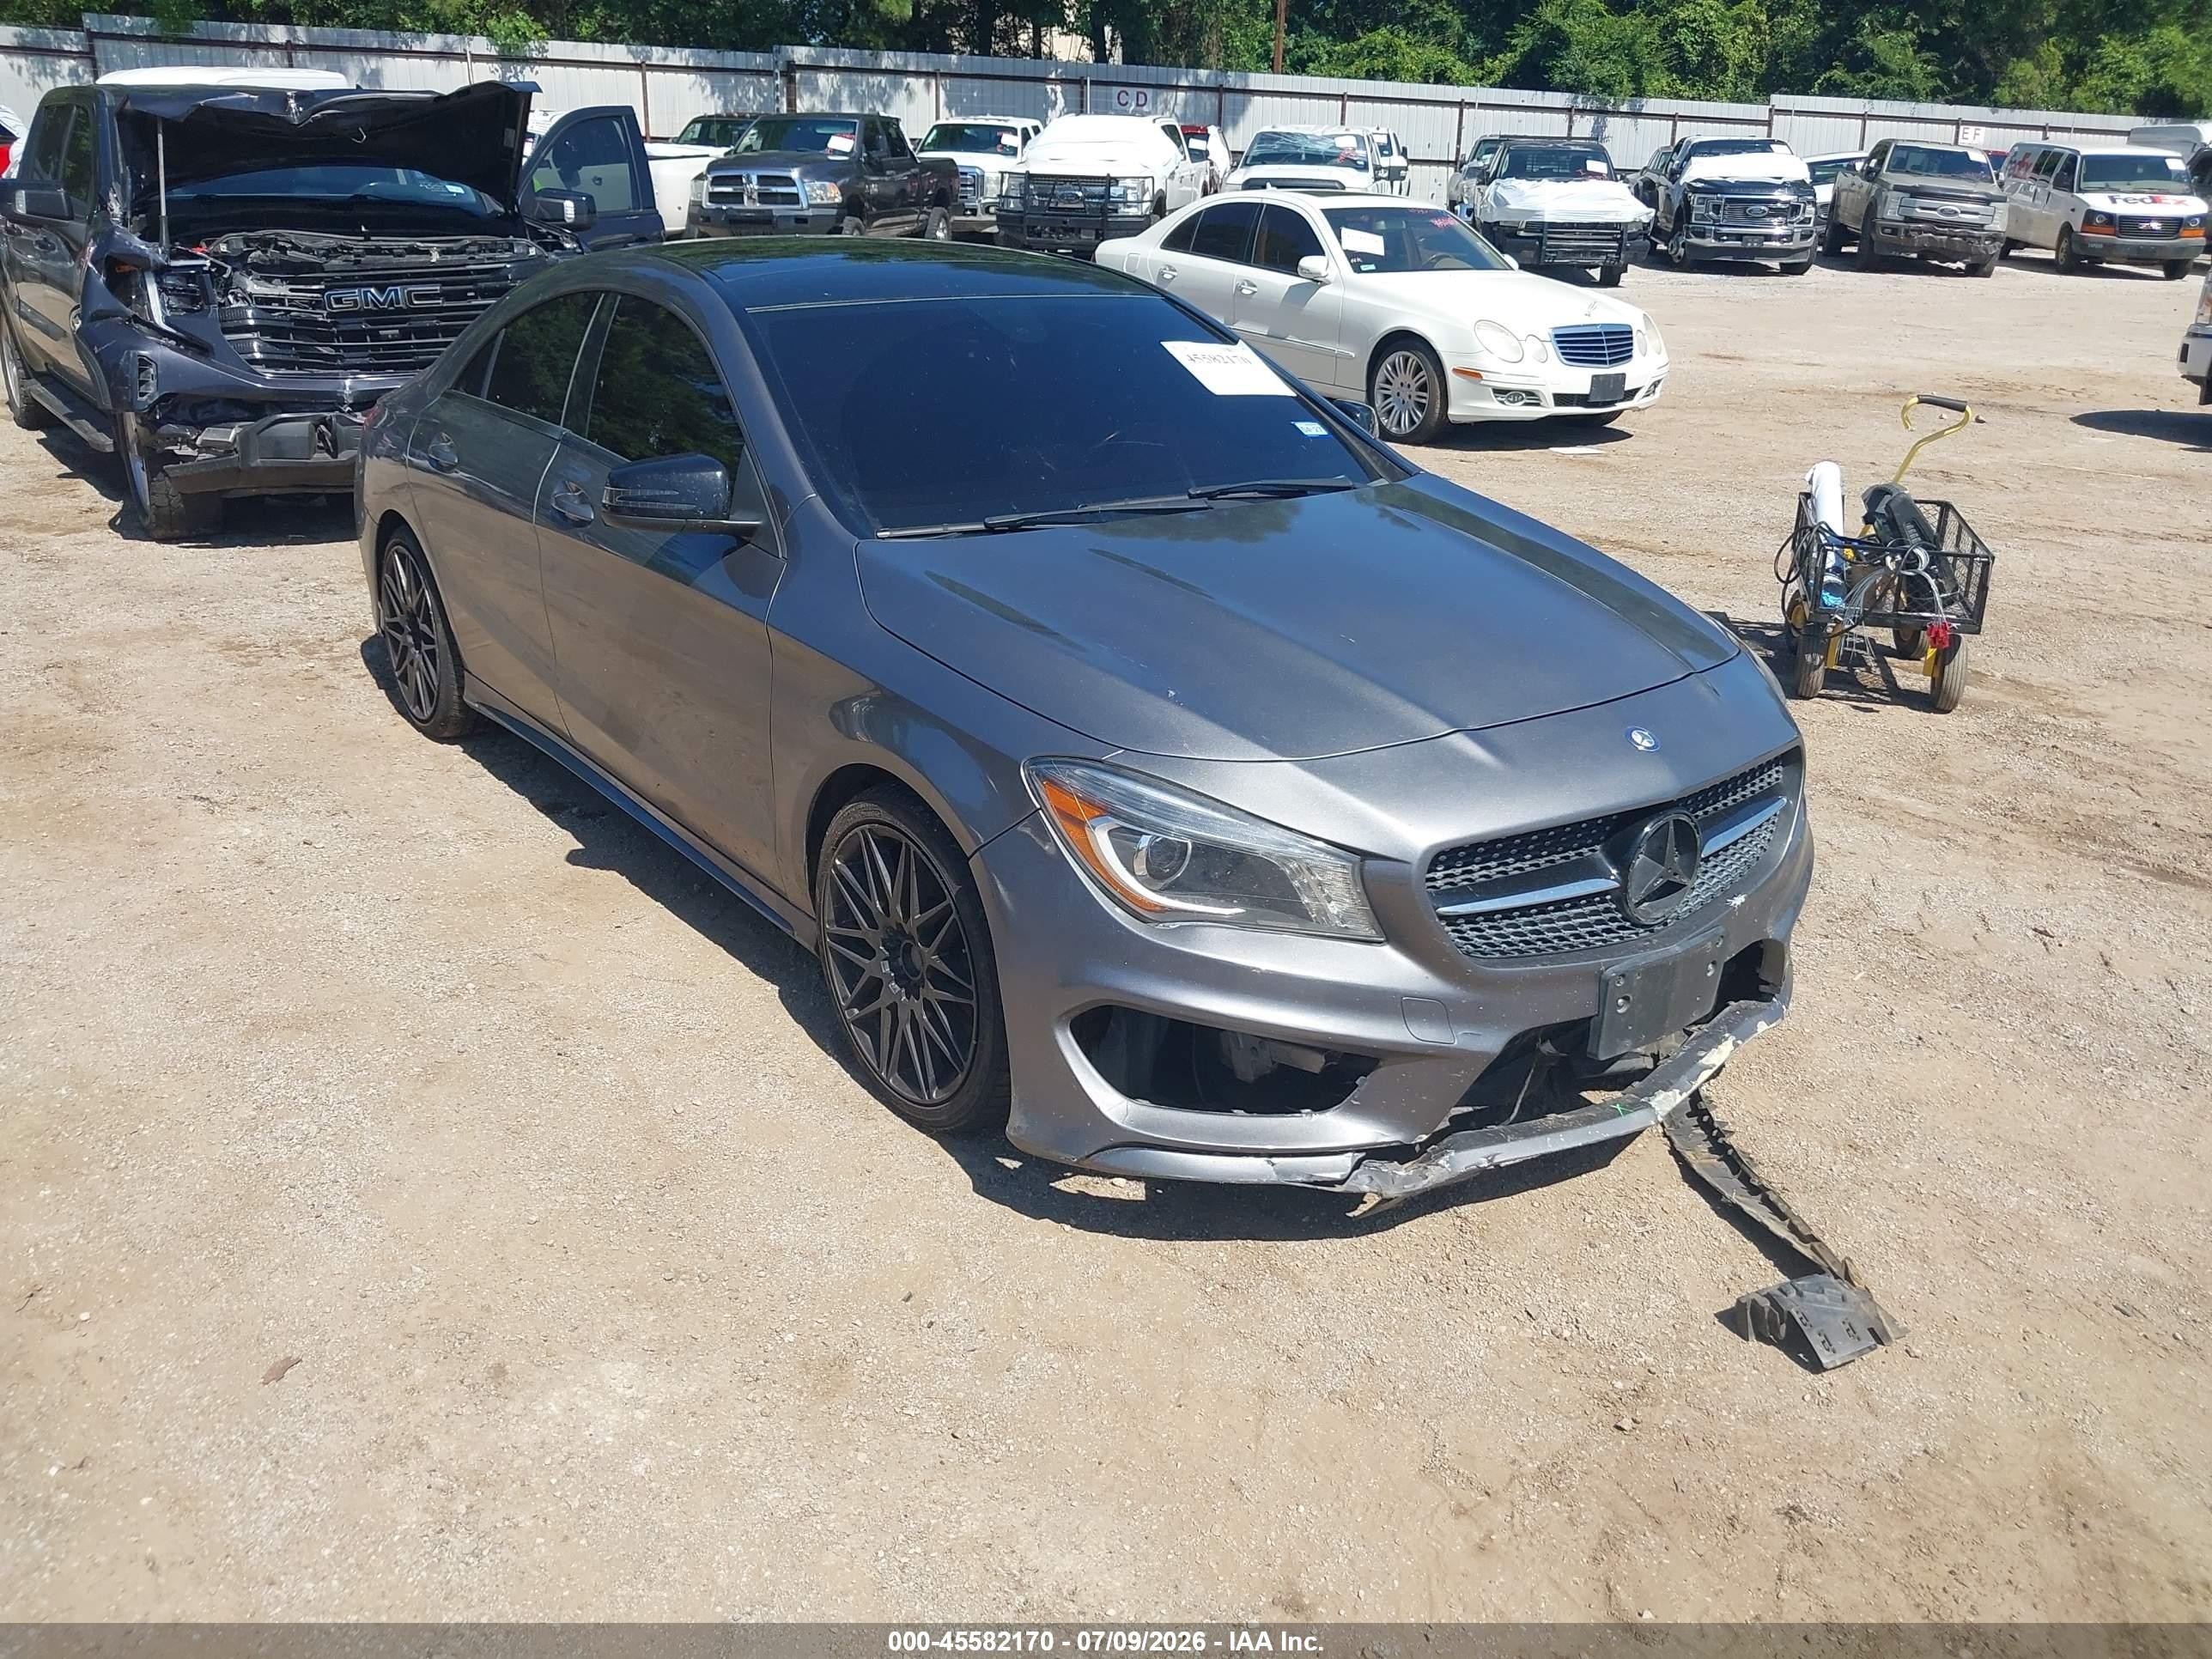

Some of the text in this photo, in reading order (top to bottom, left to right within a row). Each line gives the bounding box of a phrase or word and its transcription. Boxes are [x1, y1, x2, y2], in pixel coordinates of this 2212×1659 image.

[1117, 89, 1148, 107] C D
[1962, 127, 1982, 141] E F
[2107, 194, 2191, 207] FedEx
[324, 285, 443, 313] GMC
